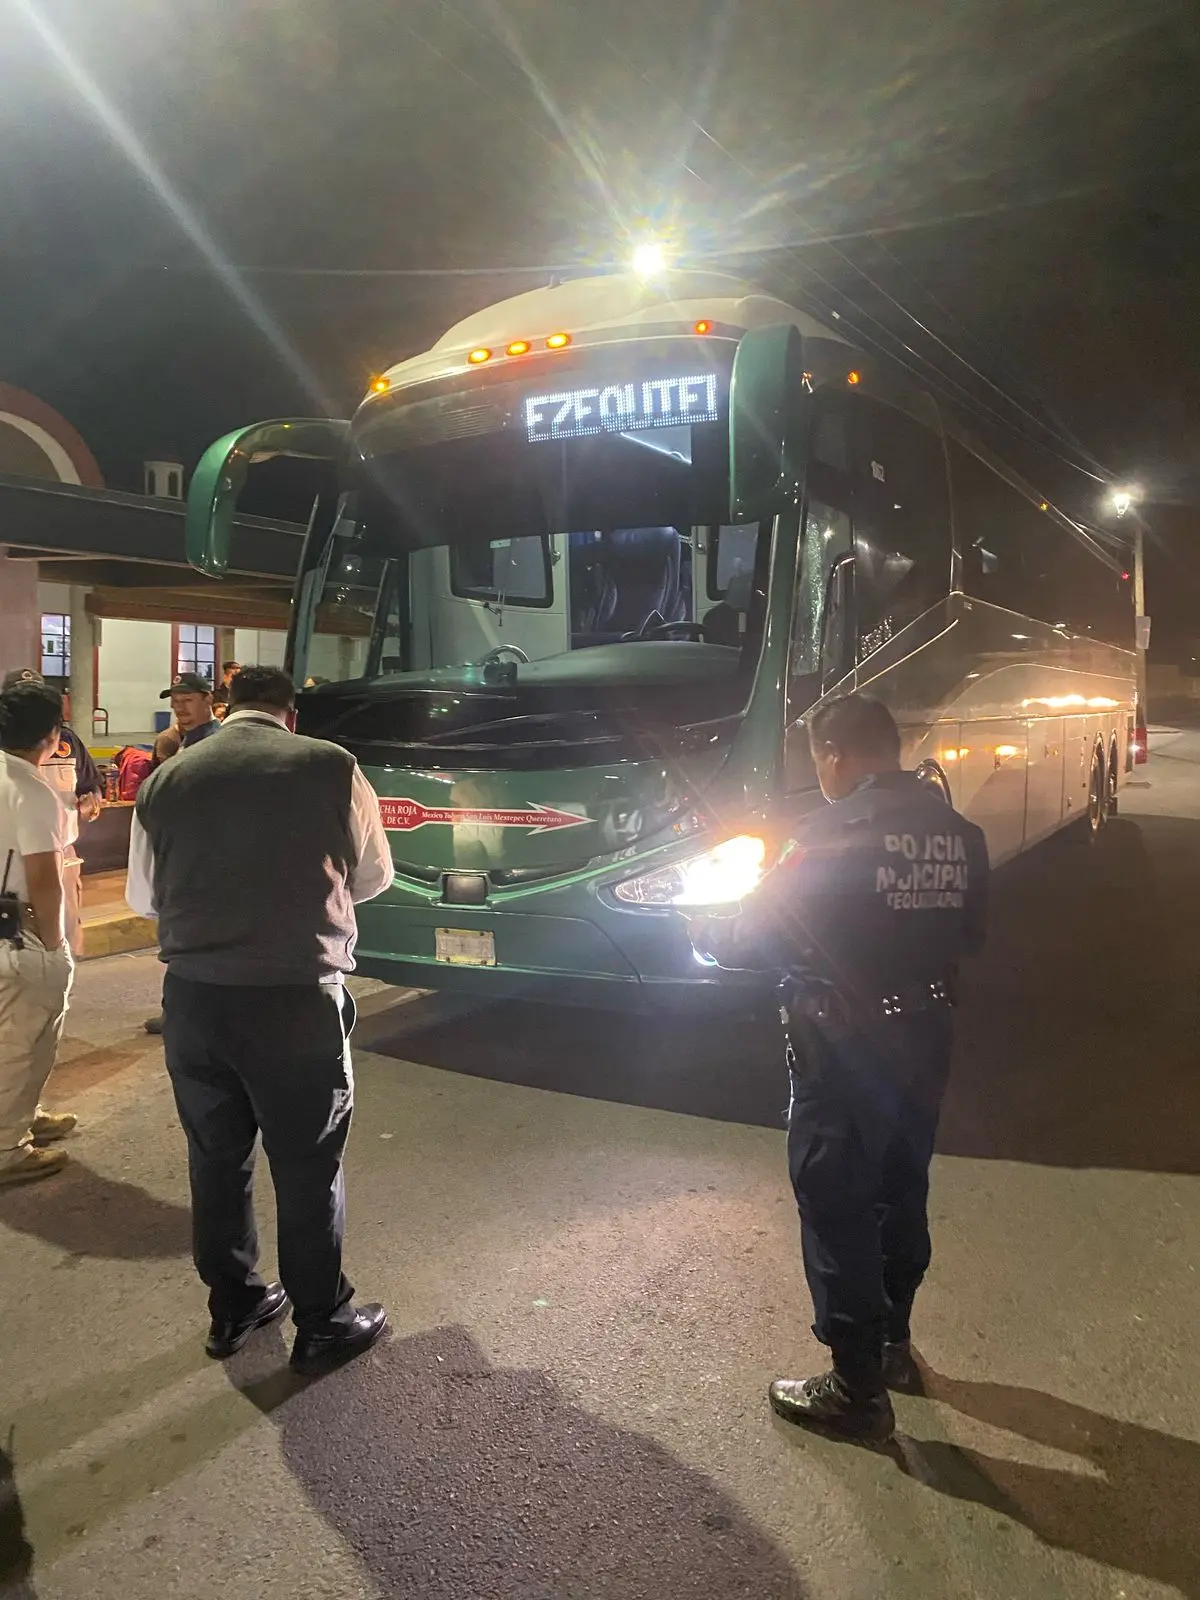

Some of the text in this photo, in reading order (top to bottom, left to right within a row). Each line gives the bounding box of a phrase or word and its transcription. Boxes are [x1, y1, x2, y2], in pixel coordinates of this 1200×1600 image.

[397, 805, 417, 817] ROJA
[479, 812, 493, 820] Luis
[386, 816, 396, 825] DE
[884, 834, 967, 861] POICIA
[876, 863, 968, 893] MUCIPAL
